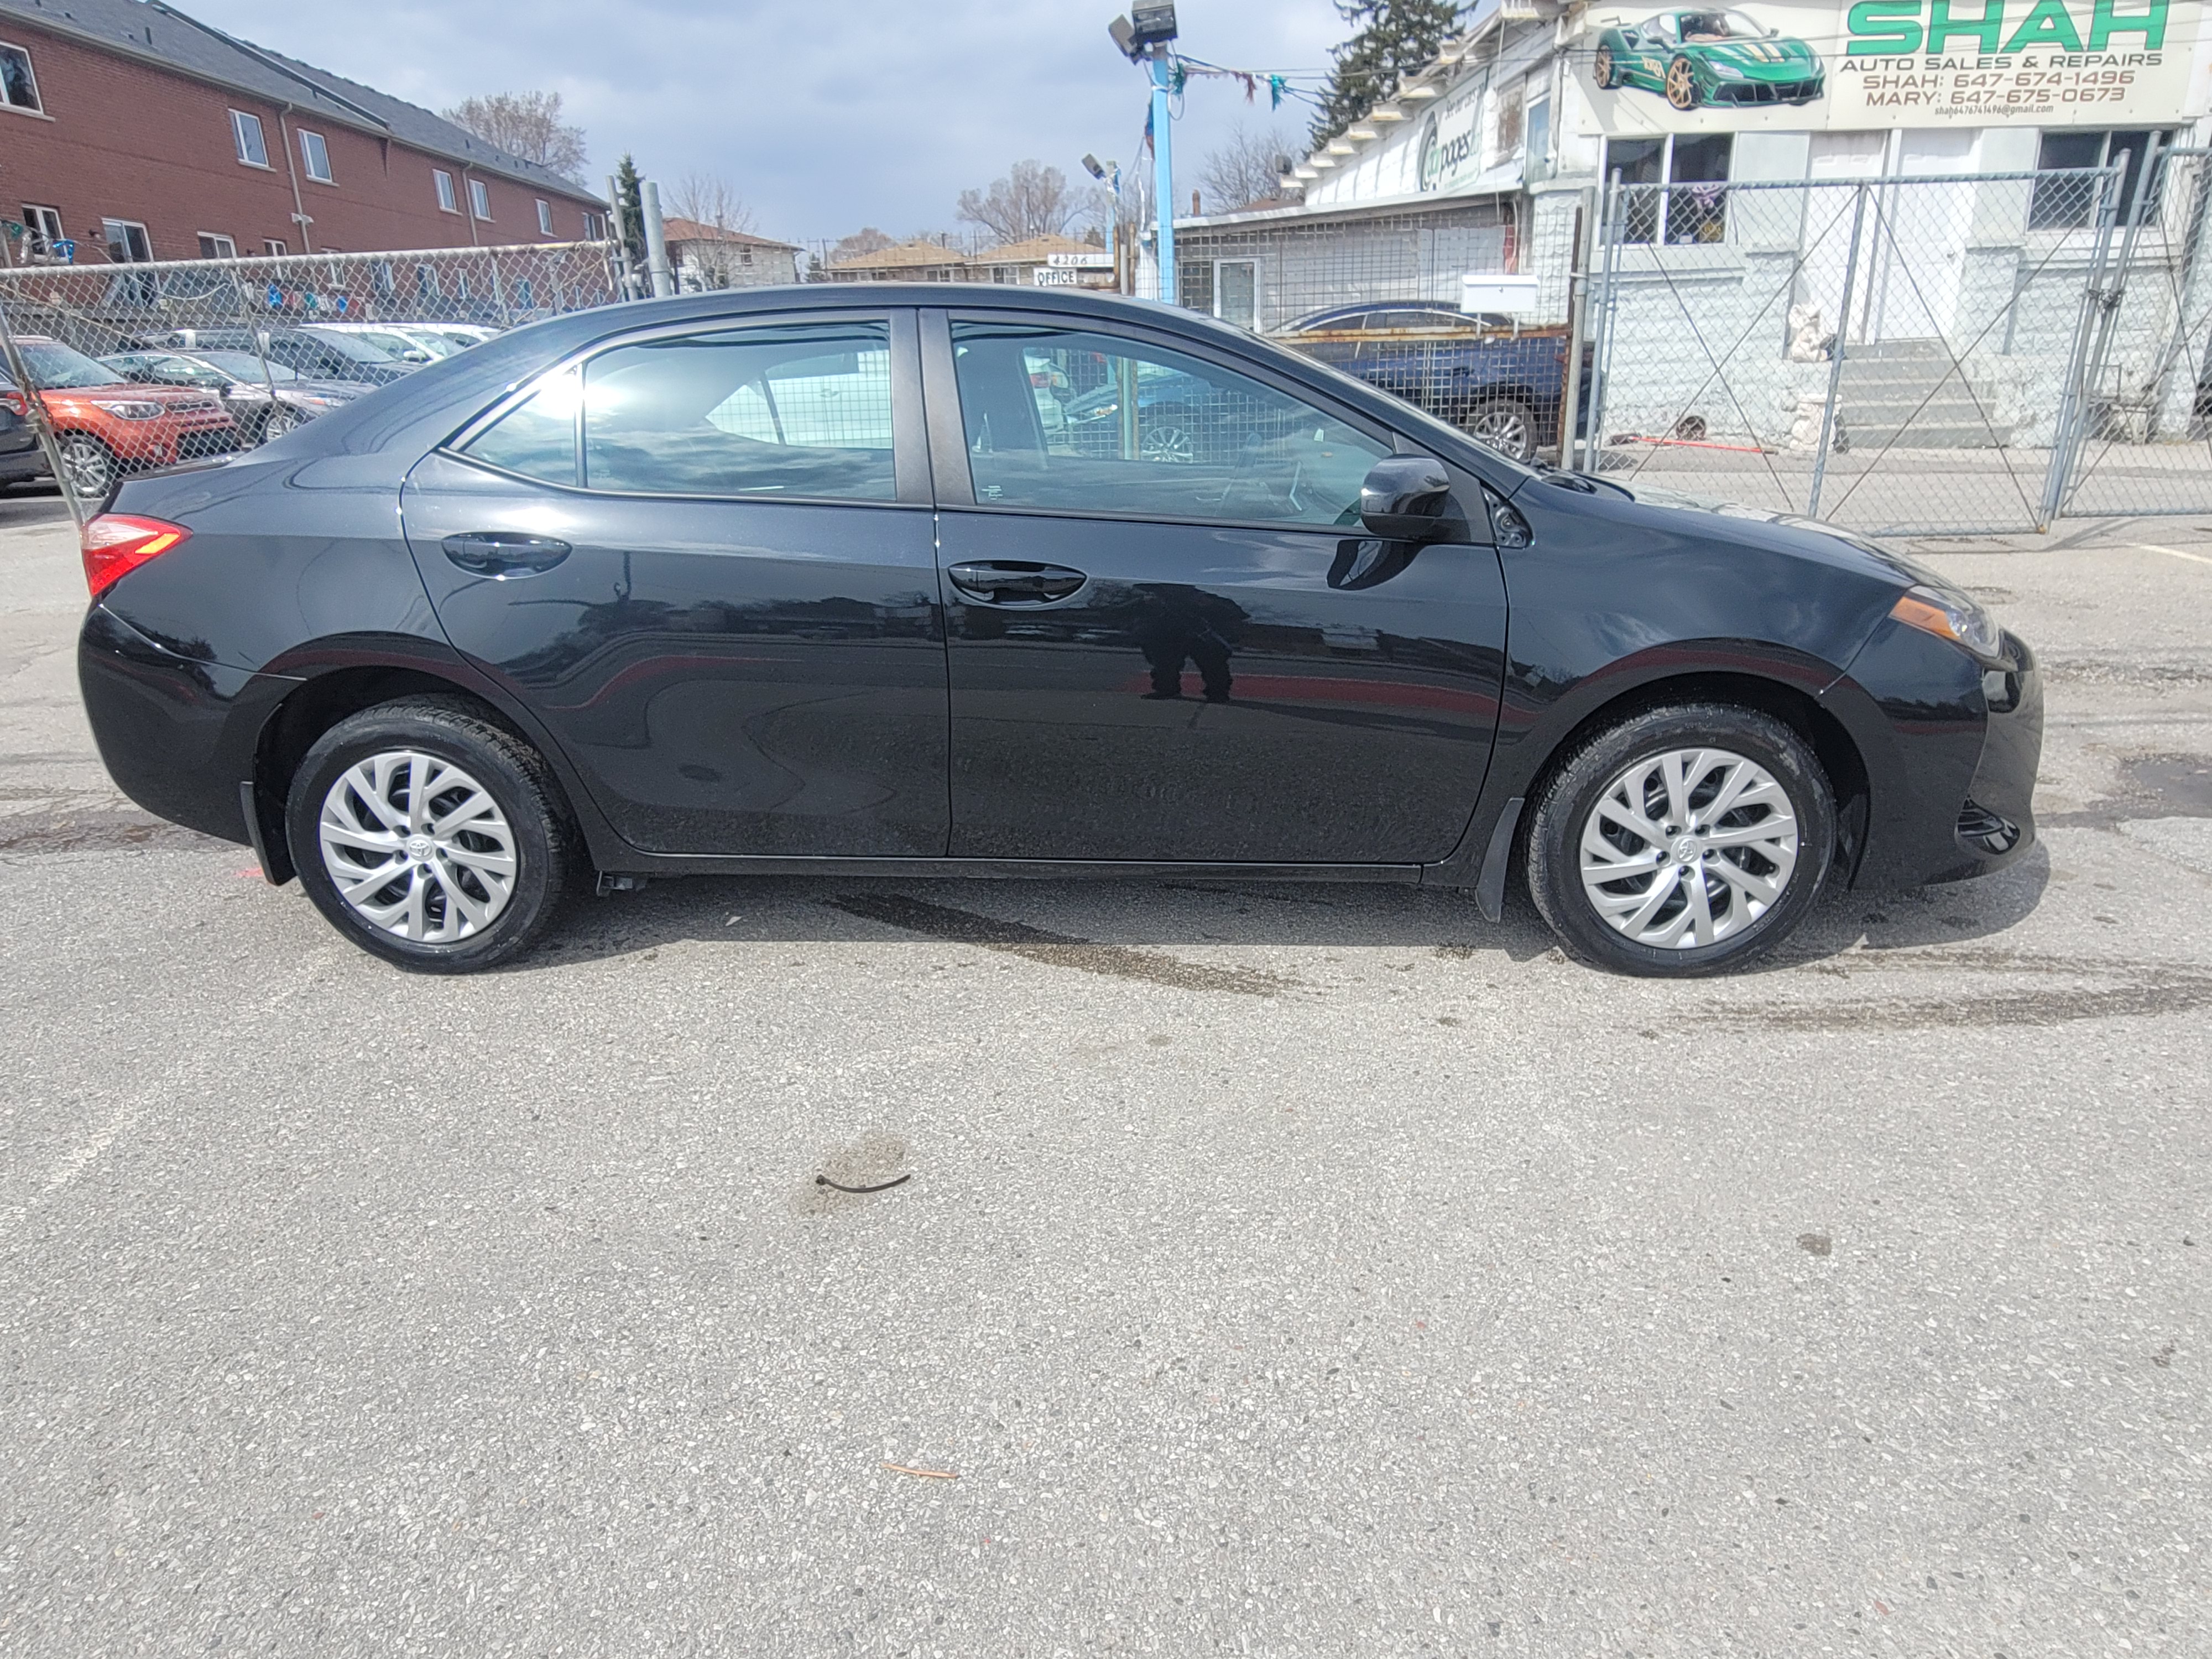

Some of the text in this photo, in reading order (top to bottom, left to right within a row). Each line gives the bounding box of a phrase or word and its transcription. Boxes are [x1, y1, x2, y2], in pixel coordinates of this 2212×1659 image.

[1847, 0, 2169, 55] SHAH
[1840, 53, 2162, 72] AUTO SALES & REPAIRS
[1863, 70, 2135, 89] SHAH: 647-674-1496
[1866, 87, 2126, 106] MARY: 647-675-0673
[1053, 255, 1088, 265] 4206
[1037, 271, 1074, 286] OFFICE
